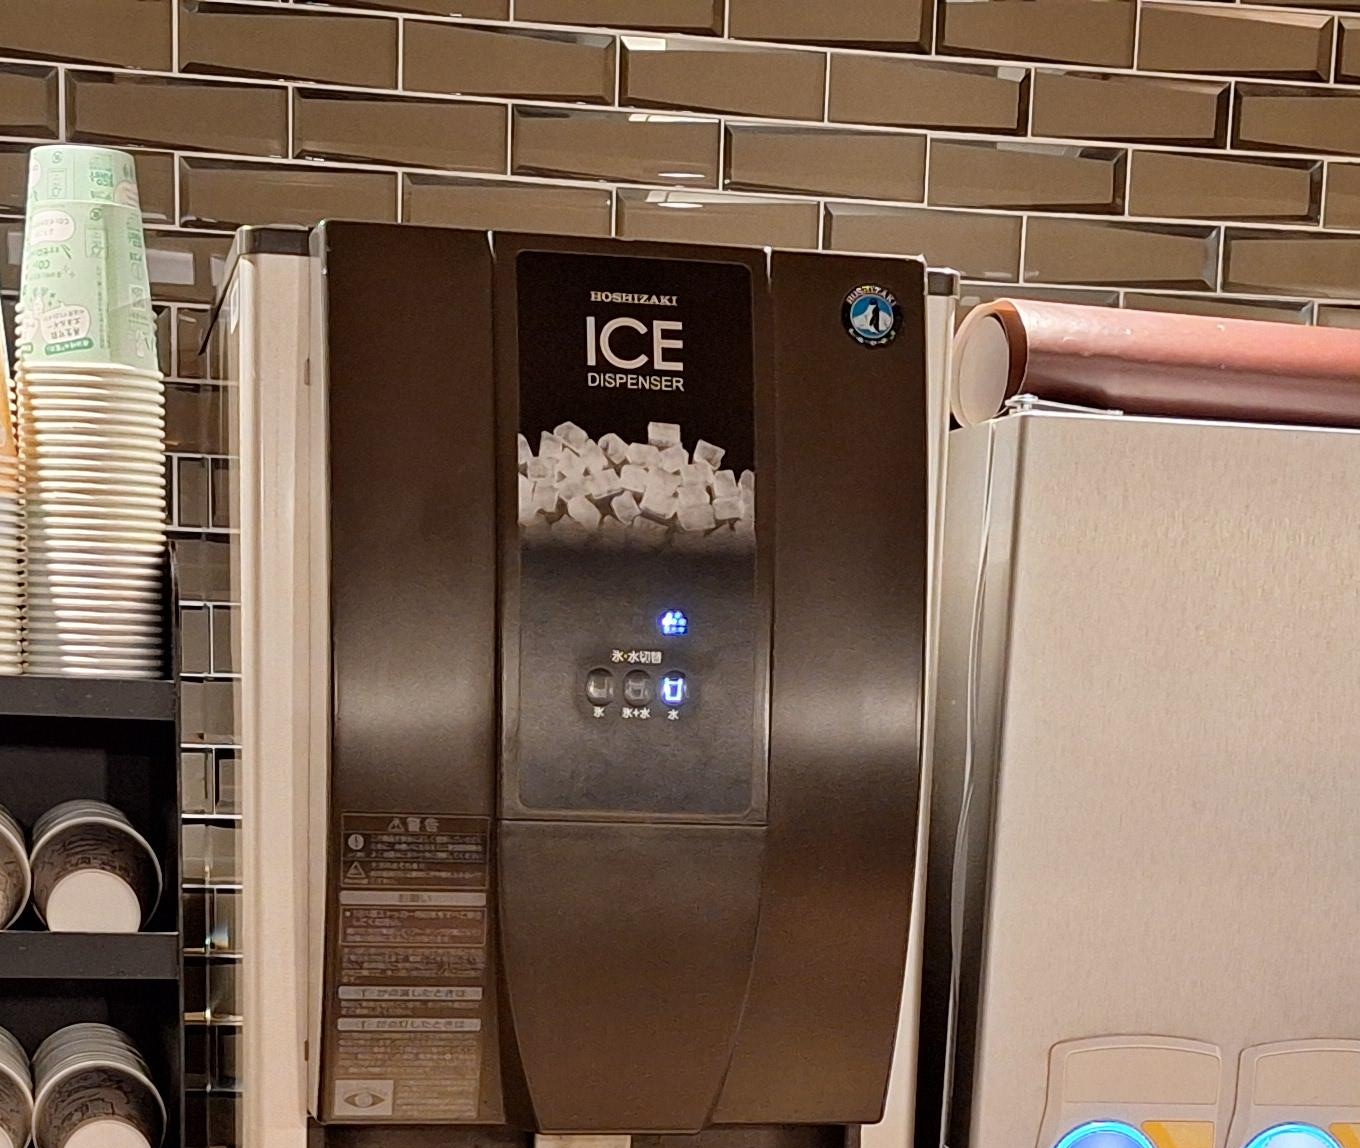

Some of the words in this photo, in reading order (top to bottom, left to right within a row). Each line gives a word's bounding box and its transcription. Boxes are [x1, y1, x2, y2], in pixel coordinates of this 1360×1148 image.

[590, 291, 678, 306] HOSHIZAKI
[586, 316, 684, 371] ICE
[587, 372, 685, 392] DISPENSER
